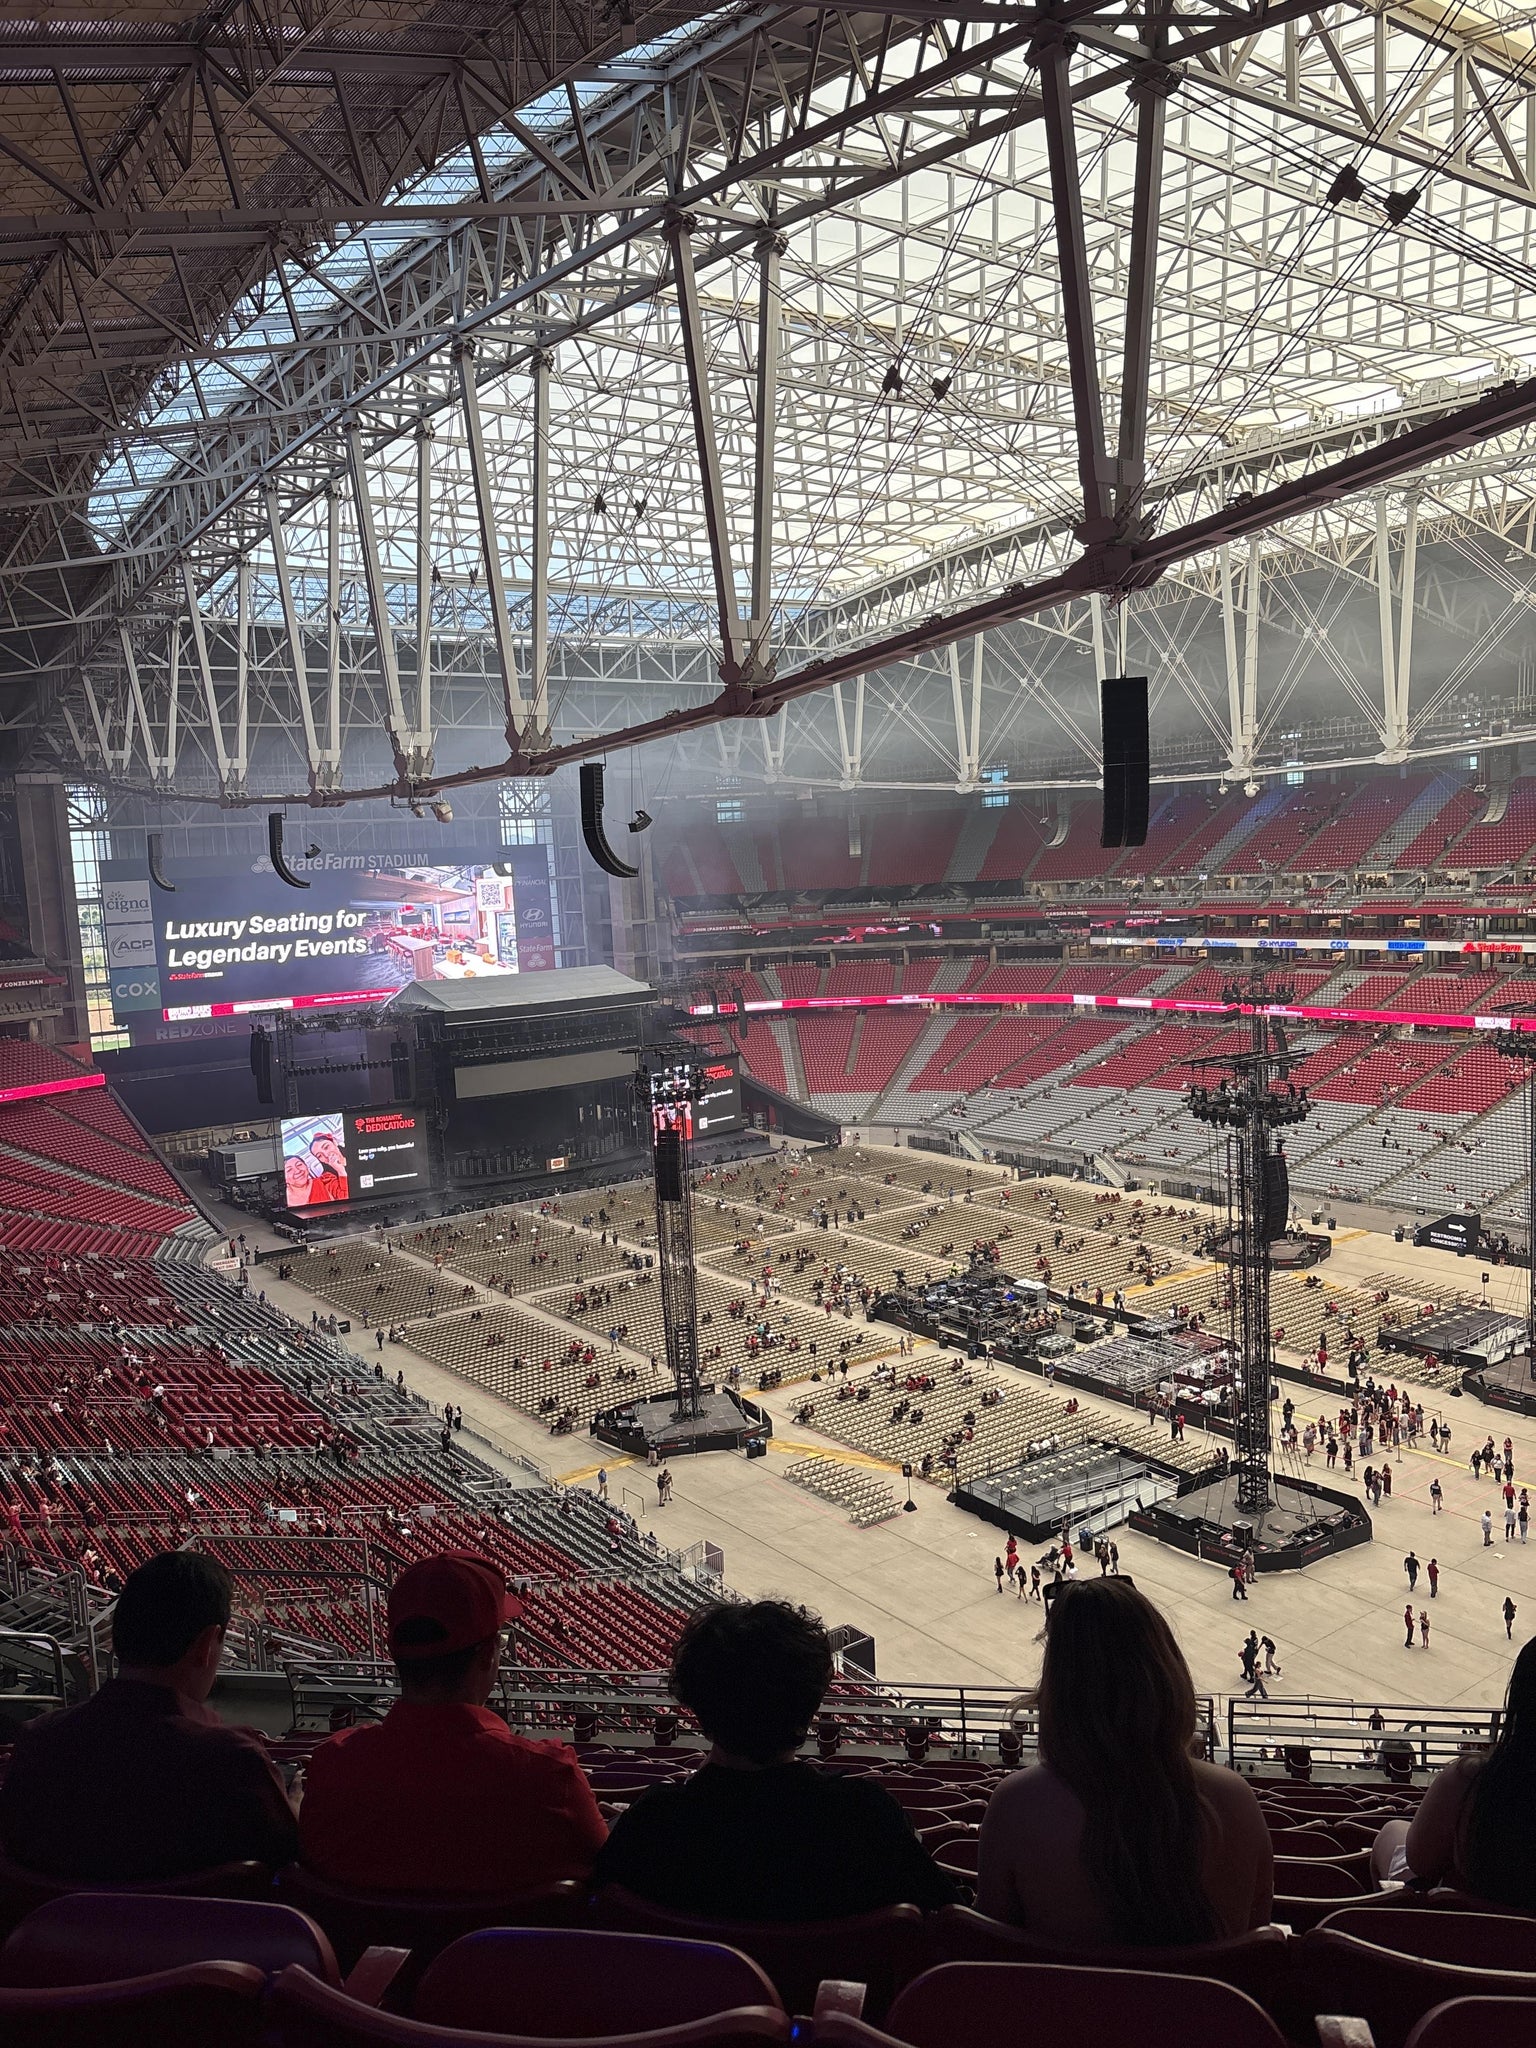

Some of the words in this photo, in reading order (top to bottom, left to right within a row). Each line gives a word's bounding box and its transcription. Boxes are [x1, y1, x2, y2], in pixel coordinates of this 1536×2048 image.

[368, 853, 429, 869] STADIUM
[106, 897, 150, 913] cigna
[165, 920, 247, 940] Luxury
[249, 912, 332, 936] Seating
[336, 909, 367, 927] for
[520, 921, 549, 929] HYUNDAI
[118, 939, 153, 951] ACP
[1268, 940, 1298, 948] HYUNDAI
[1330, 941, 1350, 949] COX
[168, 942, 293, 969] Legendary
[294, 936, 367, 958] Events
[4, 979, 44, 988] CONZELMAN
[115, 981, 158, 999] COX
[376, 1114, 402, 1122] ROMANTIC
[366, 1119, 415, 1133] DEDICATIONS
[1430, 1231, 1462, 1242] RESTROOMS
